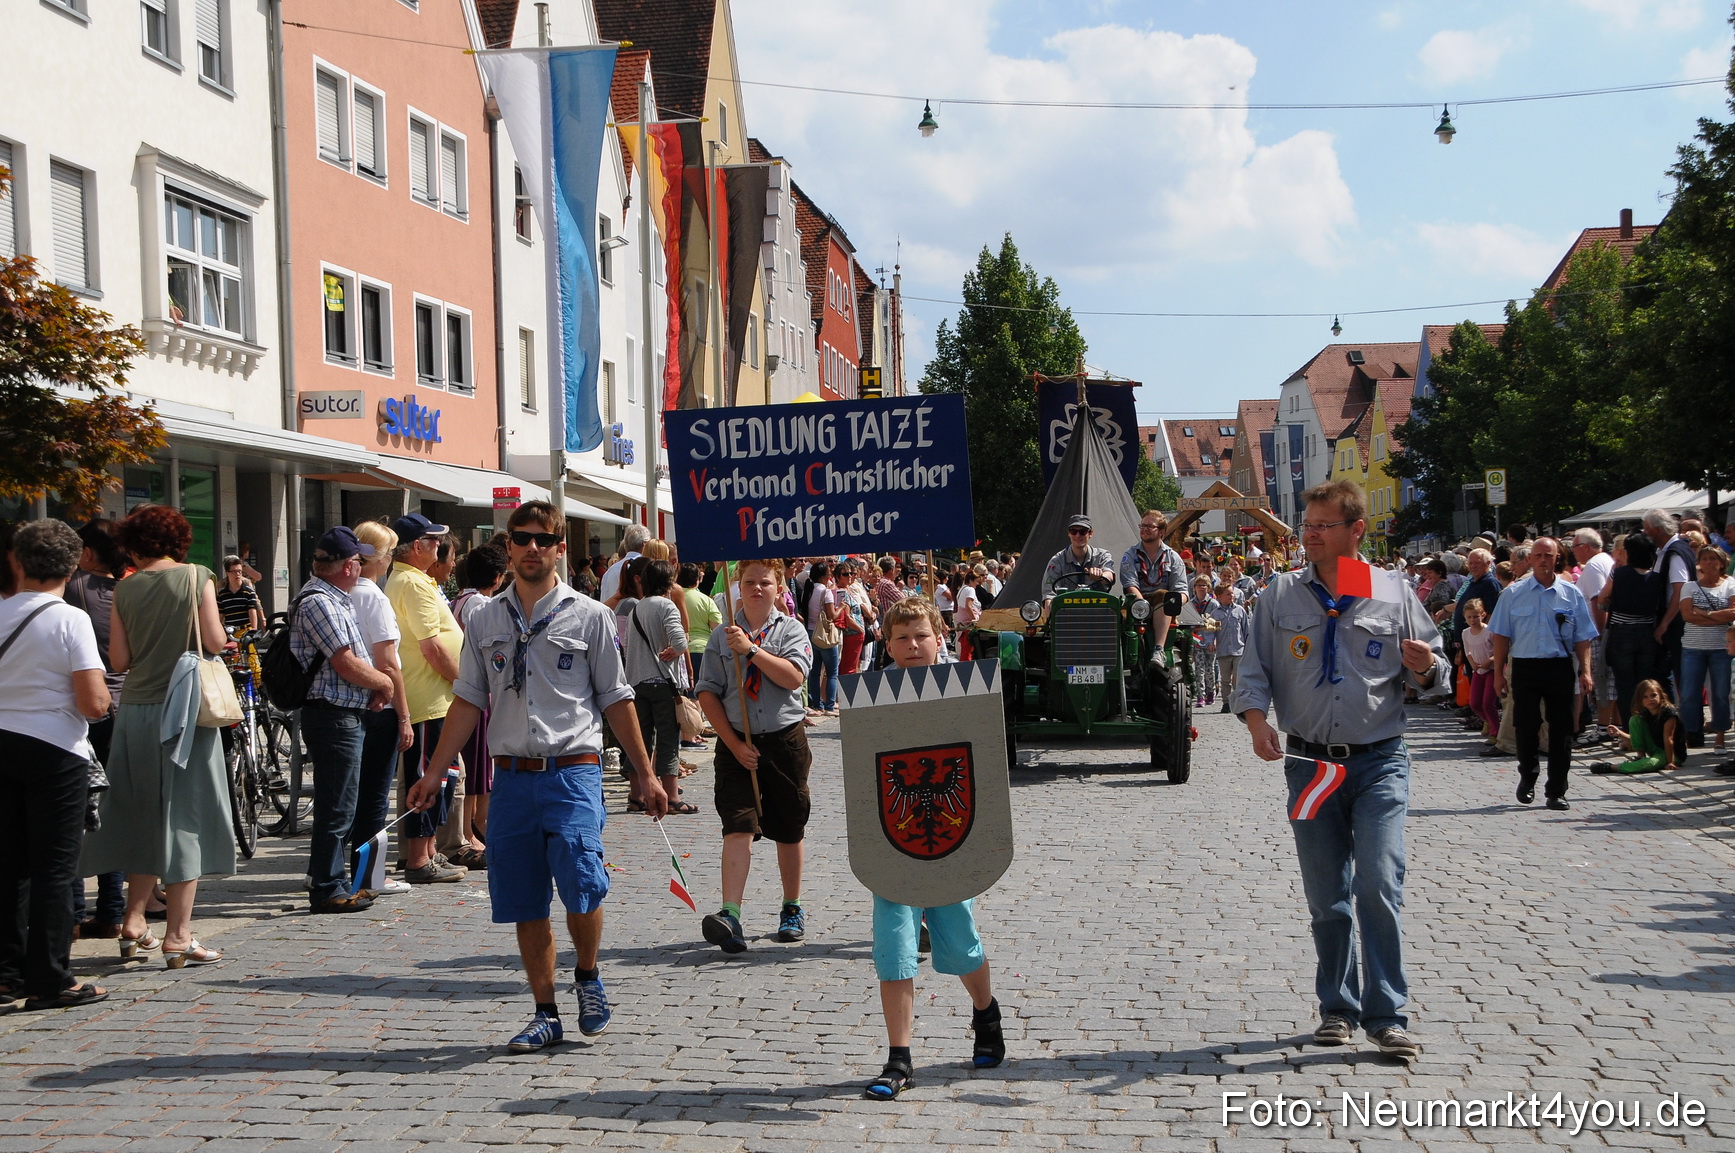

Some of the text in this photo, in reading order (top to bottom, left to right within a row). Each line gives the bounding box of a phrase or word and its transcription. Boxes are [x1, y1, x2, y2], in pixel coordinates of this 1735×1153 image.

[689, 400, 934, 460] SIEDLUNG TAIZÉ
[689, 464, 796, 503] Verband
[804, 457, 955, 496] Christlicher
[736, 502, 900, 548] Pfadfinder
[1075, 667, 1088, 675] NM
[1084, 675, 1095, 683] 48
